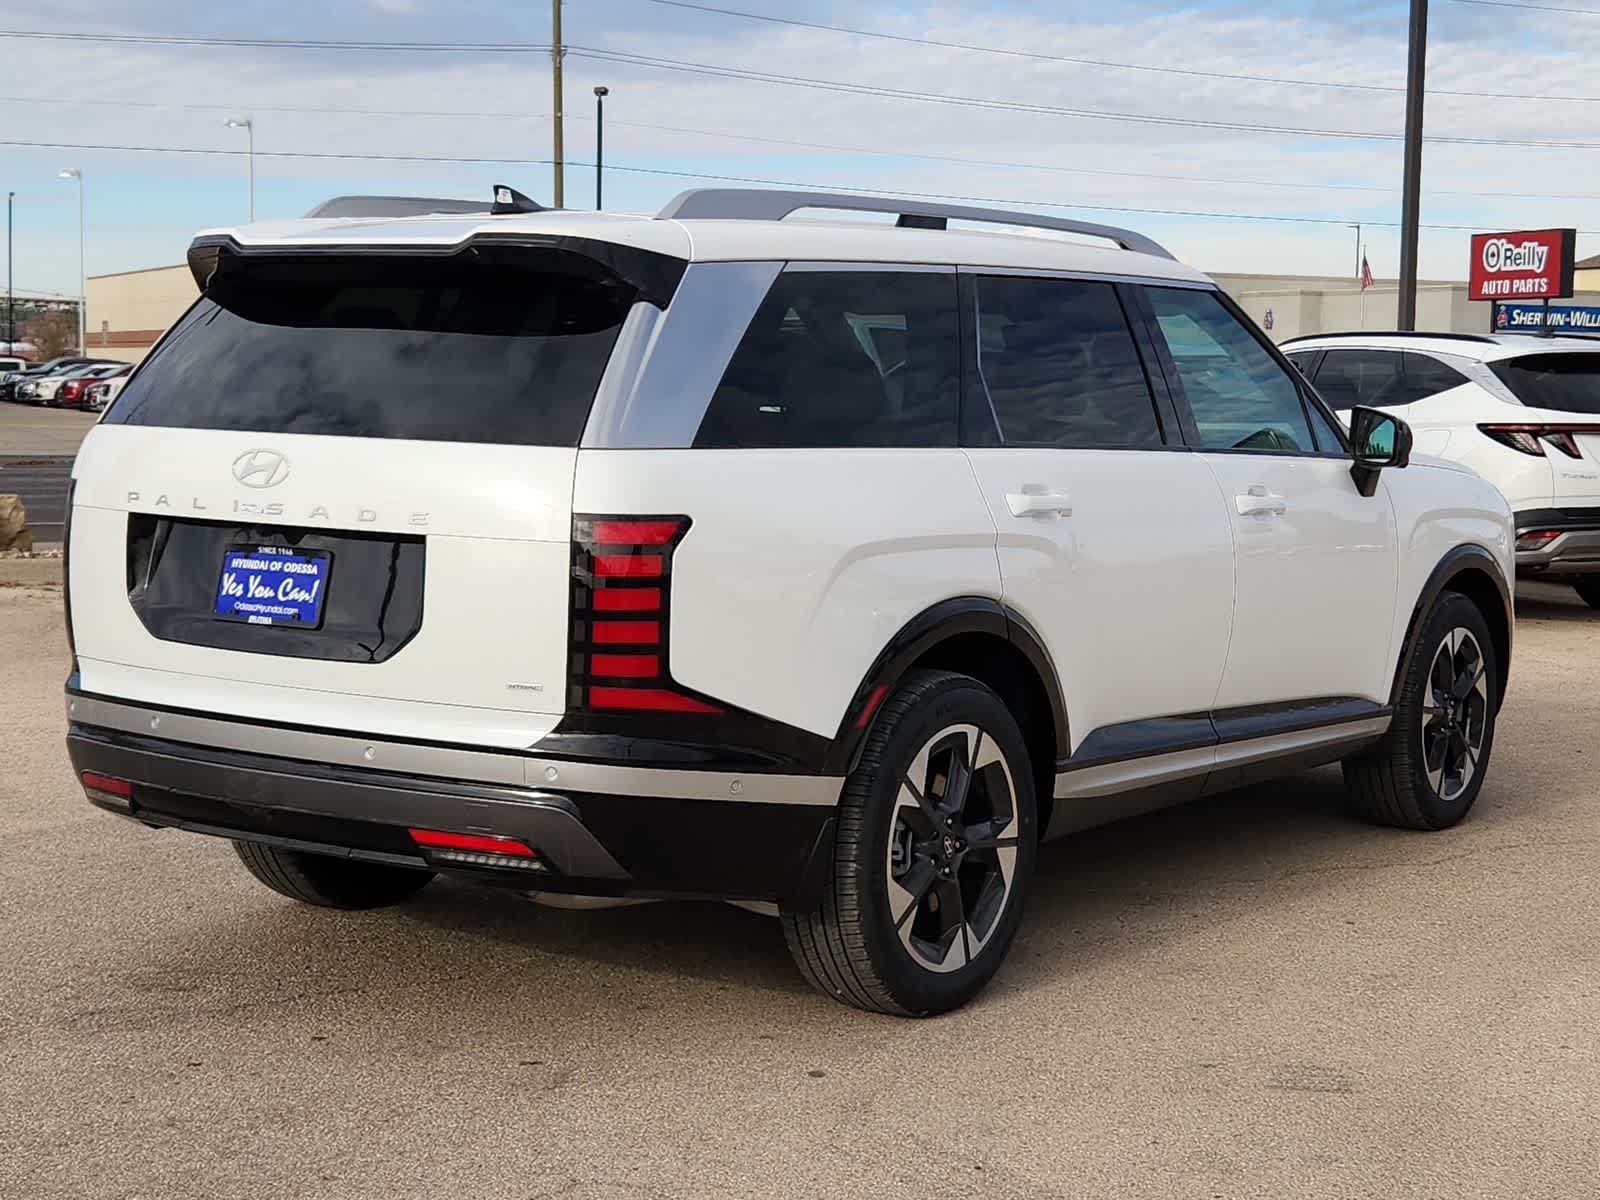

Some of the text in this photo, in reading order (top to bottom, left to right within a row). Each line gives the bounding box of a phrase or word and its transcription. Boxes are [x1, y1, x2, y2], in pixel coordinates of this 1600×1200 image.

[1483, 239, 1549, 273] O'Reilly
[1481, 278, 1548, 295] AUTO PARTS
[127, 490, 431, 527] PALISADE
[231, 558, 318, 575] HYUNDAI OF ODESSA
[221, 573, 320, 603] Yes You Can!
